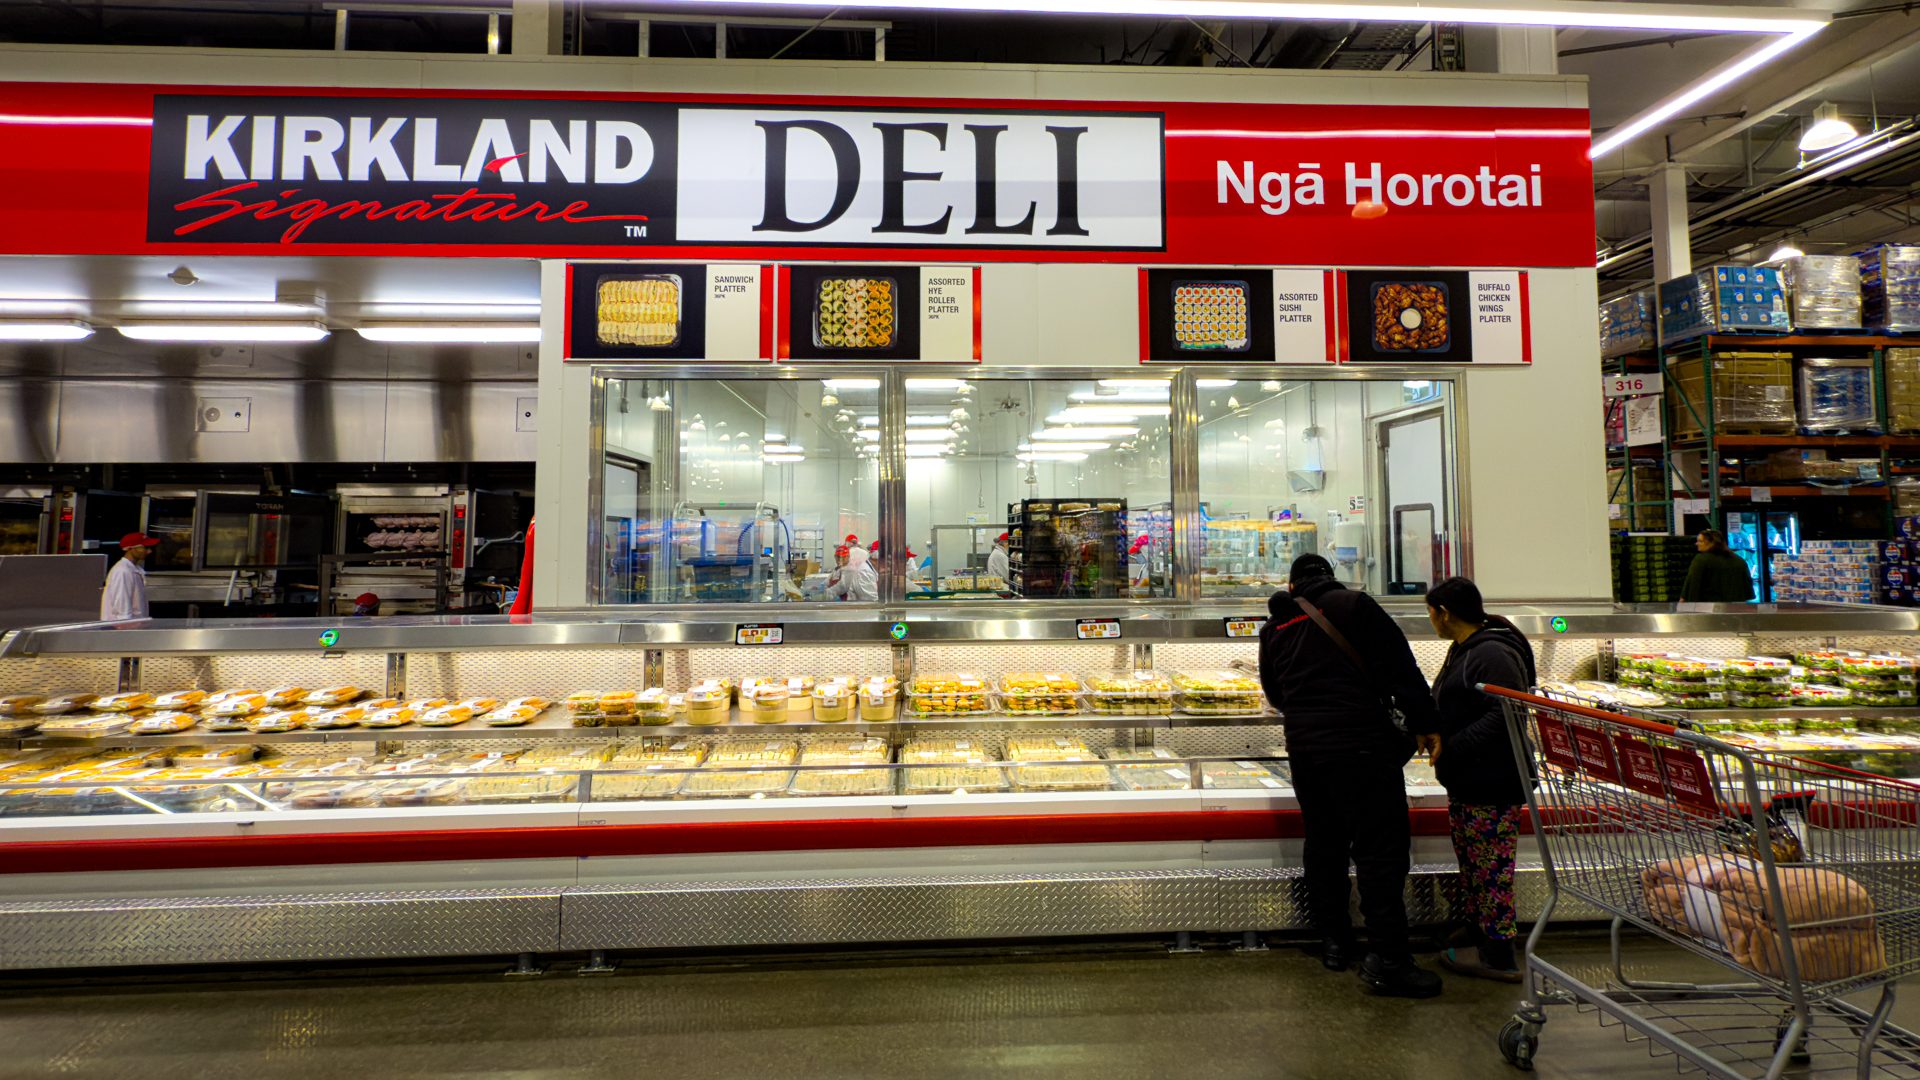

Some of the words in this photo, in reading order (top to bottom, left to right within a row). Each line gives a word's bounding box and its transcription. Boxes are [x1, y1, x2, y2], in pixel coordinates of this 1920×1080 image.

[184, 114, 655, 185] KIRKLAND
[752, 119, 1090, 237] DELI
[1216, 160, 1325, 215] Ngā
[1344, 161, 1542, 207] Horotai
[173, 181, 649, 243] Signature
[624, 225, 648, 237] TM
[714, 275, 754, 284] SANDWICH
[928, 278, 966, 286] ASSORTED
[714, 285, 746, 293] PLATTER
[928, 287, 943, 295] HYE
[1477, 283, 1511, 291] BUFFALO
[928, 296, 956, 304] ROLLER
[1279, 293, 1318, 301] ASSORTED
[1478, 294, 1511, 302] CHICKEN
[928, 305, 960, 313] PLATTER
[1279, 304, 1302, 312] SUSHI
[1280, 314, 1312, 322] PLATTER
[1479, 315, 1512, 323] PLATTER
[1615, 379, 1643, 392] 316
[1633, 771, 1659, 783] COSTCO
